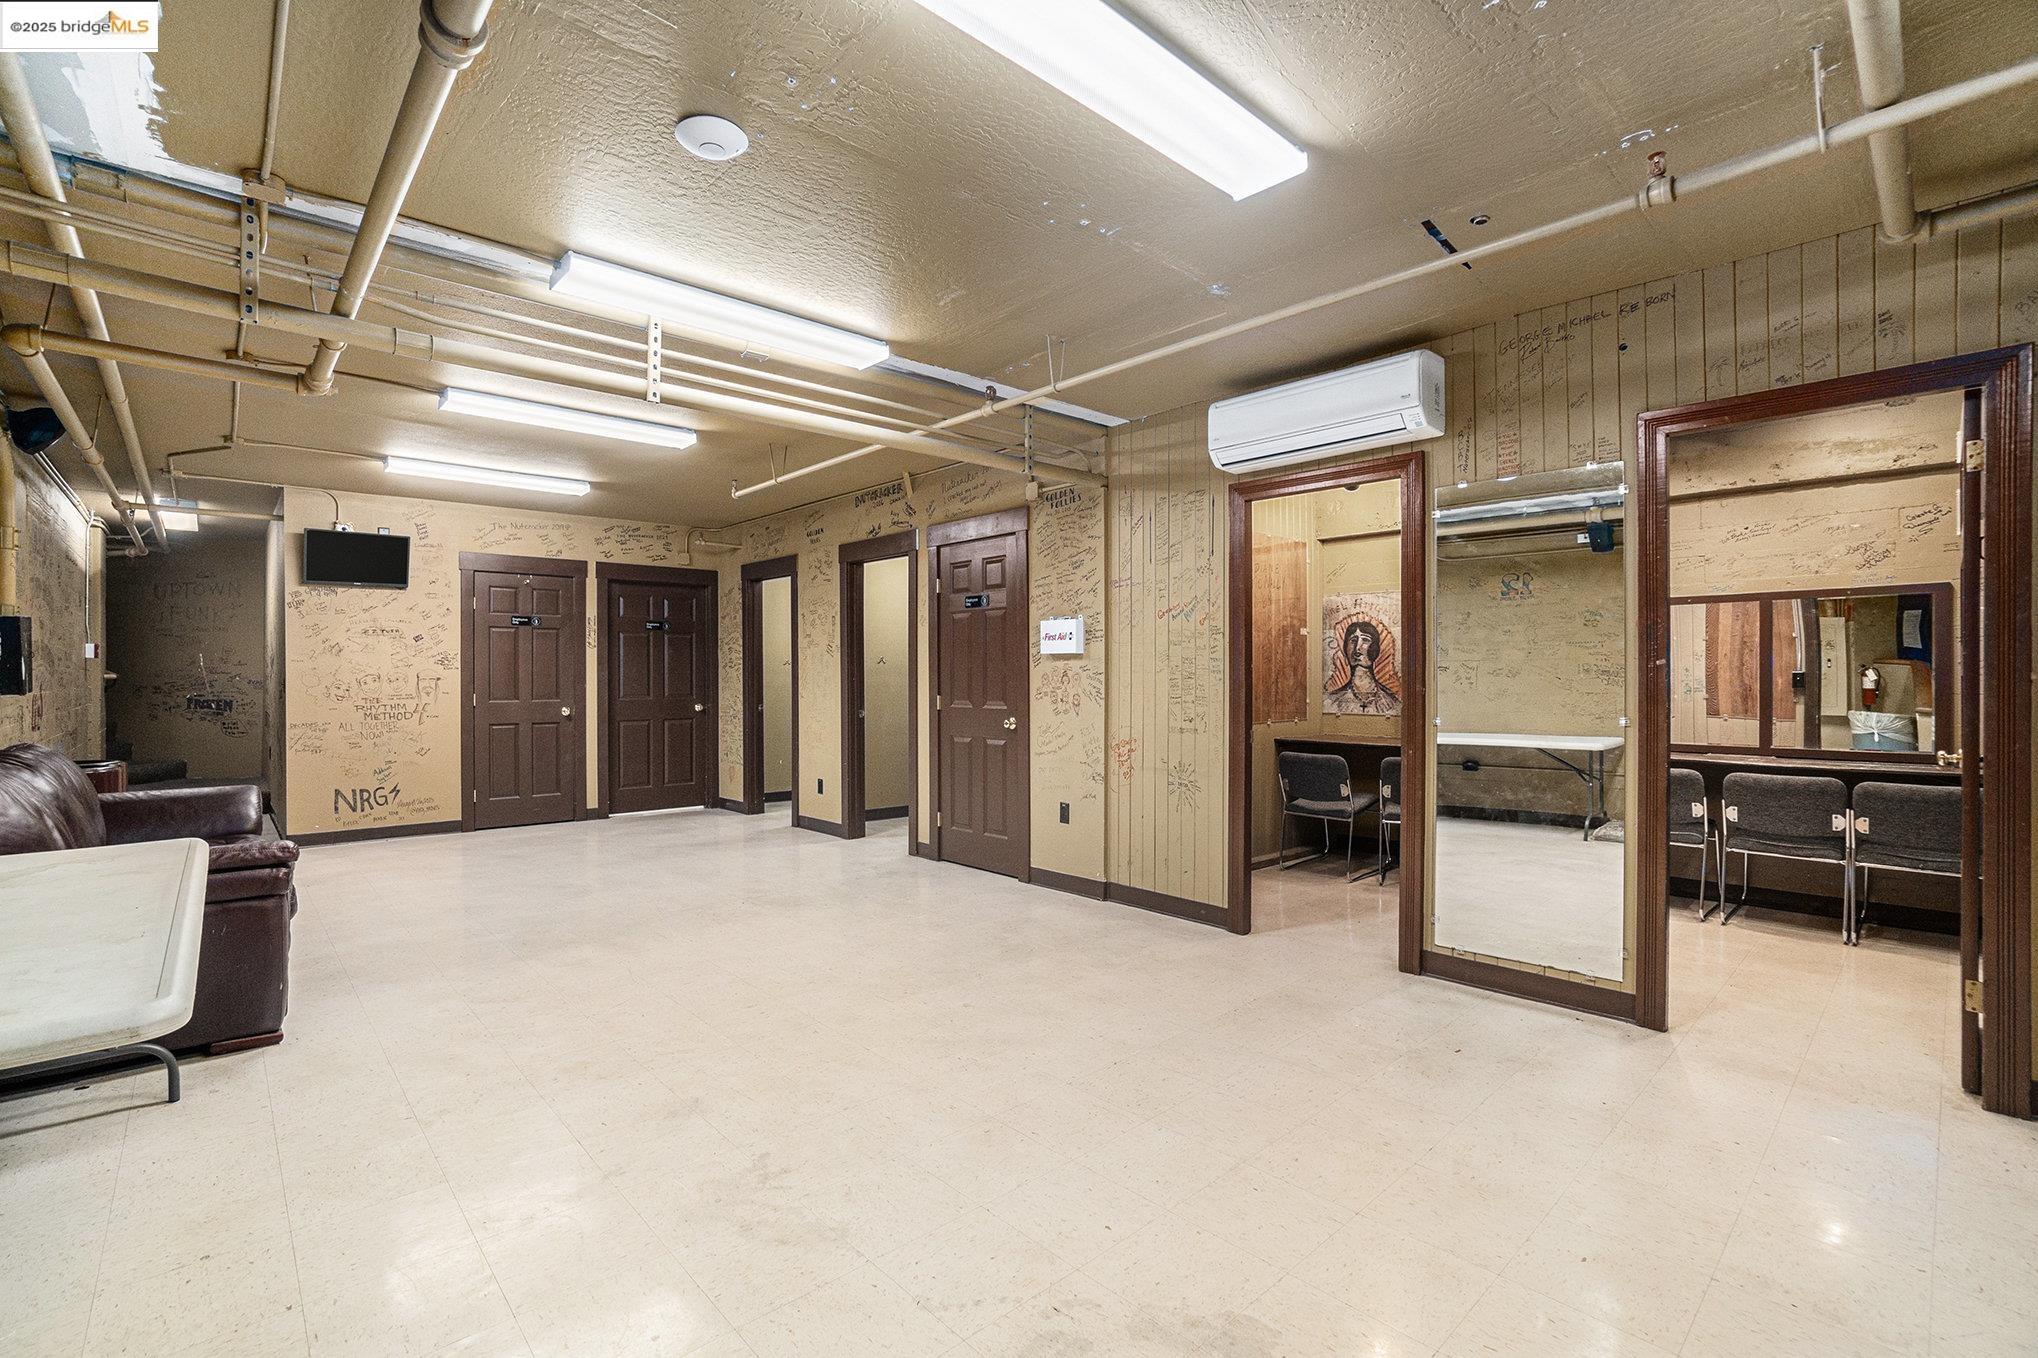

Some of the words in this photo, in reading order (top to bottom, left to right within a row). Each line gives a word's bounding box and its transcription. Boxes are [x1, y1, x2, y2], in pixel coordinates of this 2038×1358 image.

[1499, 324, 1553, 356] GEORGE
[1557, 310, 1612, 334] MICHAEL
[1619, 301, 1640, 317] RE
[1646, 292, 1675, 308] BORN
[1046, 488, 1075, 502] GOLDEN
[1050, 494, 1082, 509] FOLLIES
[1044, 632, 1057, 642] First
[1057, 632, 1068, 641] Aid
[354, 703, 407, 713] RHYTHM
[364, 711, 414, 721] METHOD
[338, 722, 354, 732] ALL
[360, 720, 400, 731] TOGETHER
[333, 786, 388, 815] NRG
